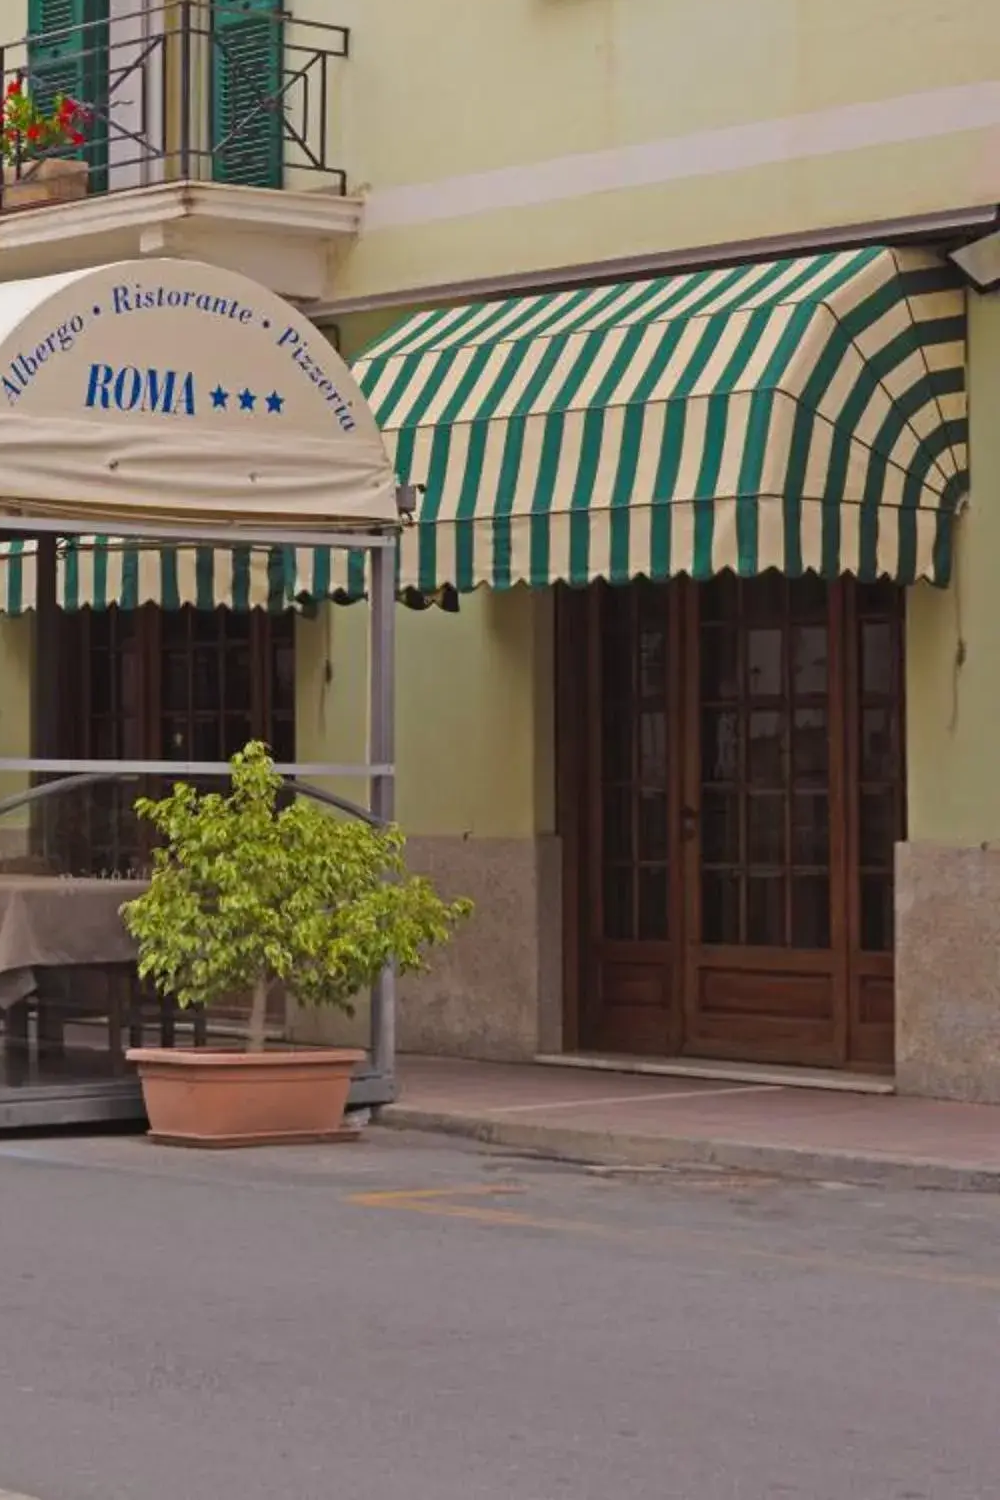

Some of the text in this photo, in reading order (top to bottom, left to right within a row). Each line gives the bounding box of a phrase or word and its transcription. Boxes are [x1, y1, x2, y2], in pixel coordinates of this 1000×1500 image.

[0, 284, 357, 433] Albergo Ristorante Pizzeria
[85, 363, 196, 415] ROMA
